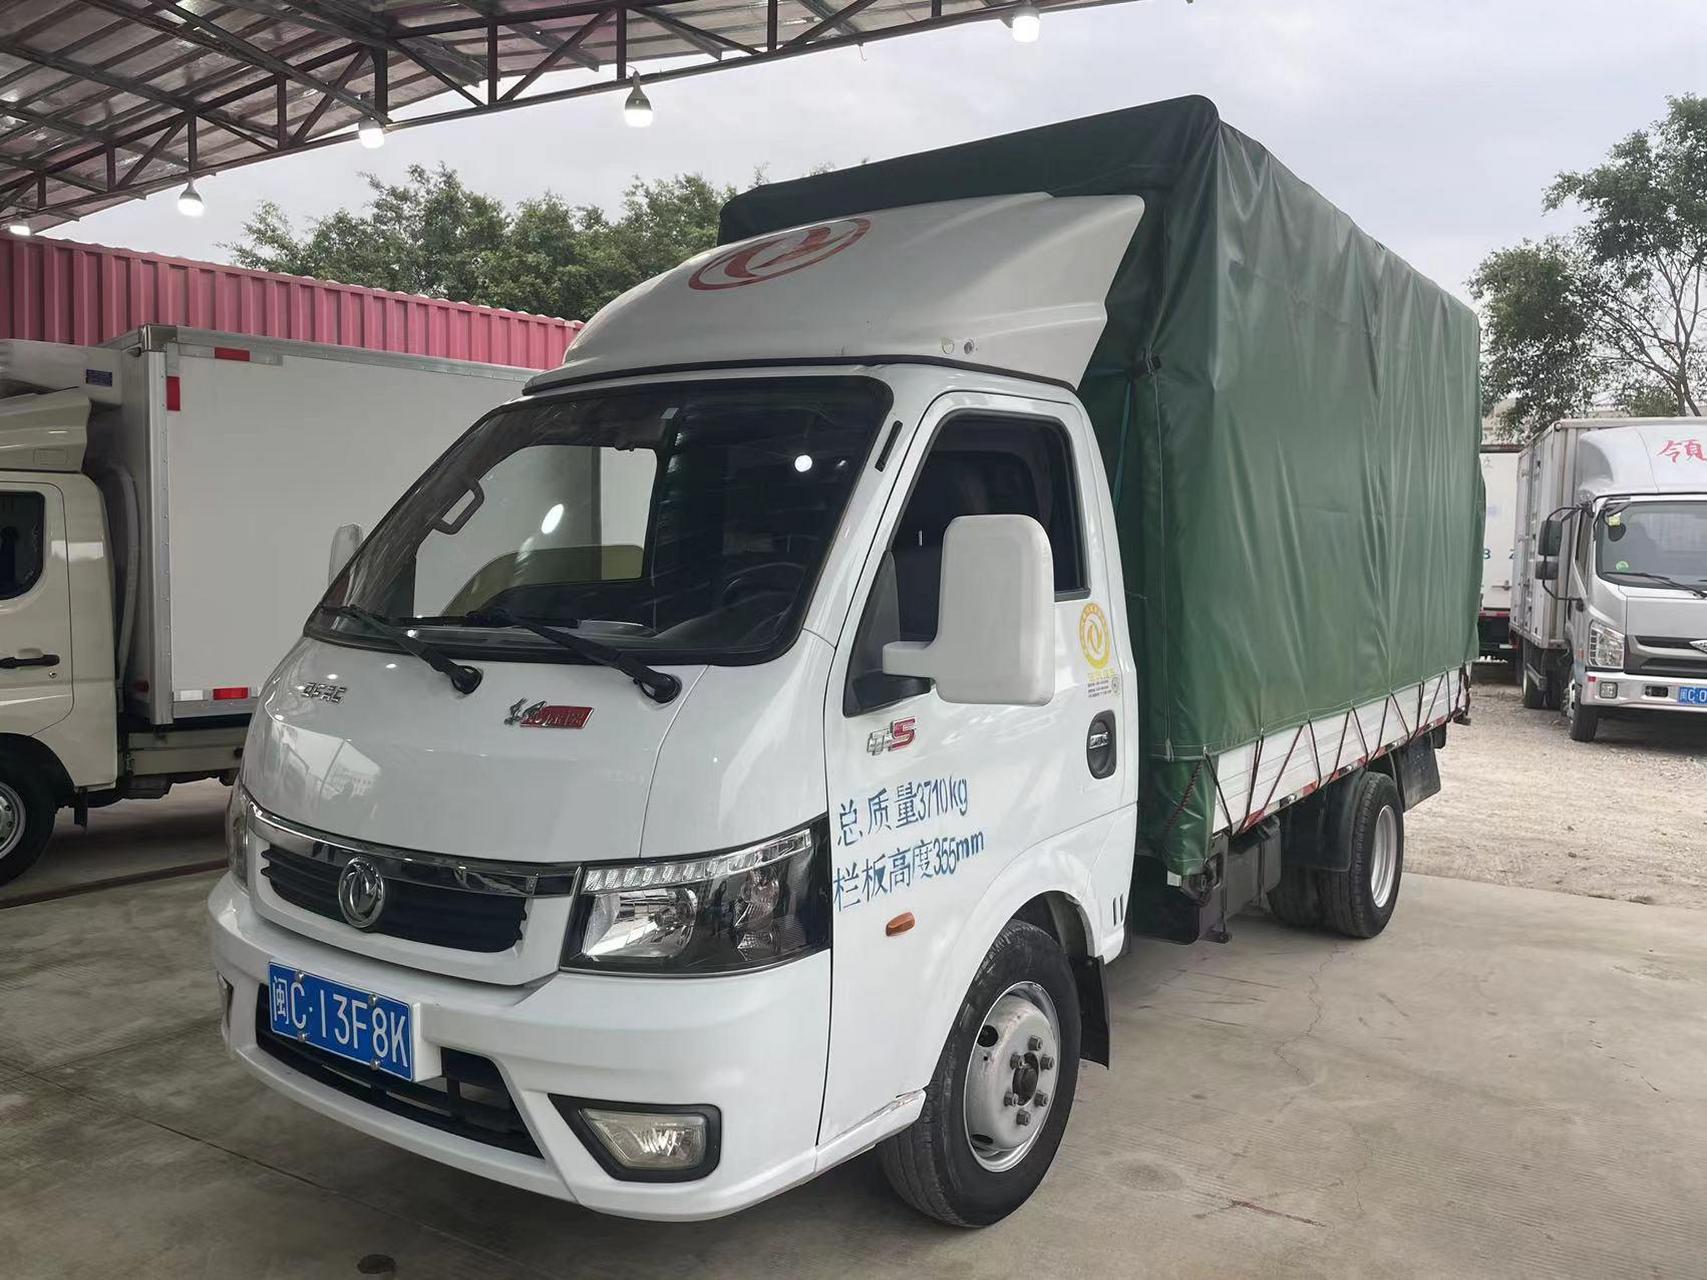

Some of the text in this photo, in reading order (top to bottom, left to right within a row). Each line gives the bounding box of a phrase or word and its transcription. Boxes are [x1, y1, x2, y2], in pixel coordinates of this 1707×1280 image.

[836, 775, 968, 847] 总质量3710kg
[832, 830, 985, 912] 栏板高度355mm
